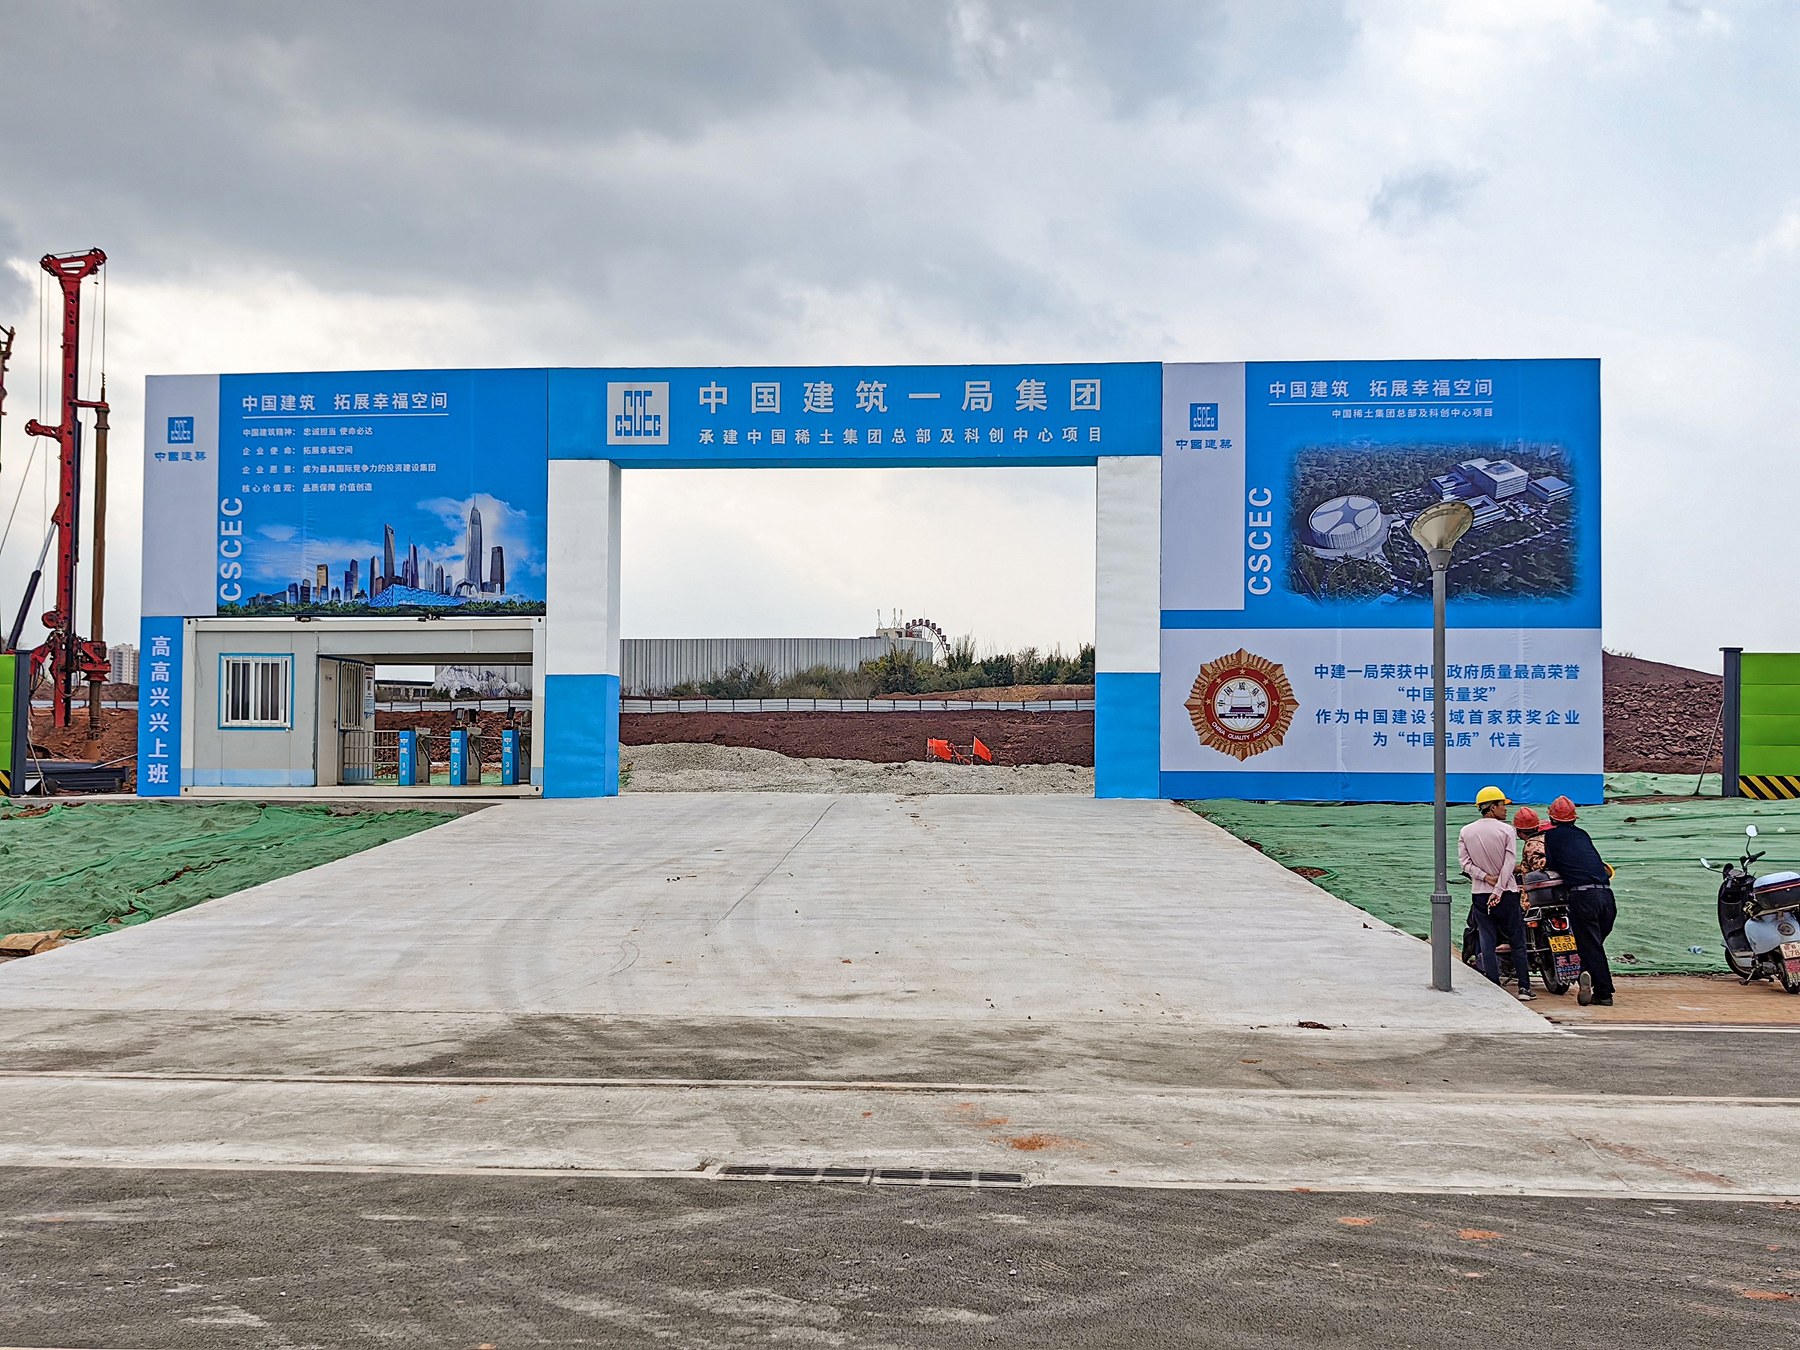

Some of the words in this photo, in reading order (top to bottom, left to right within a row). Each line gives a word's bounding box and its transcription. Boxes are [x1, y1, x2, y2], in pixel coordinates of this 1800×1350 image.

[698, 378, 1102, 414] 中国建筑一局集团
[1269, 380, 1350, 399] 中国建筑
[1369, 378, 1493, 398] 拓展幸福空间
[242, 394, 316, 412] 中国建筑
[334, 392, 448, 411] 拓展幸福空间
[1332, 408, 1493, 419] 中国稀土集团总部及科创中心项目
[698, 426, 1102, 445] 承建中国稀土集团总部及科创中心项目
[303, 445, 353, 455] 拓展幸福空间
[219, 497, 243, 602] CSCEC
[1247, 486, 1273, 596] CSCEC
[1314, 663, 1580, 680] 中建一局荣获中政府质量最高荣誉
[147, 635, 172, 785] 高高兴兴上班
[1315, 709, 1580, 725] 作为中国建设域首家获奖企业
